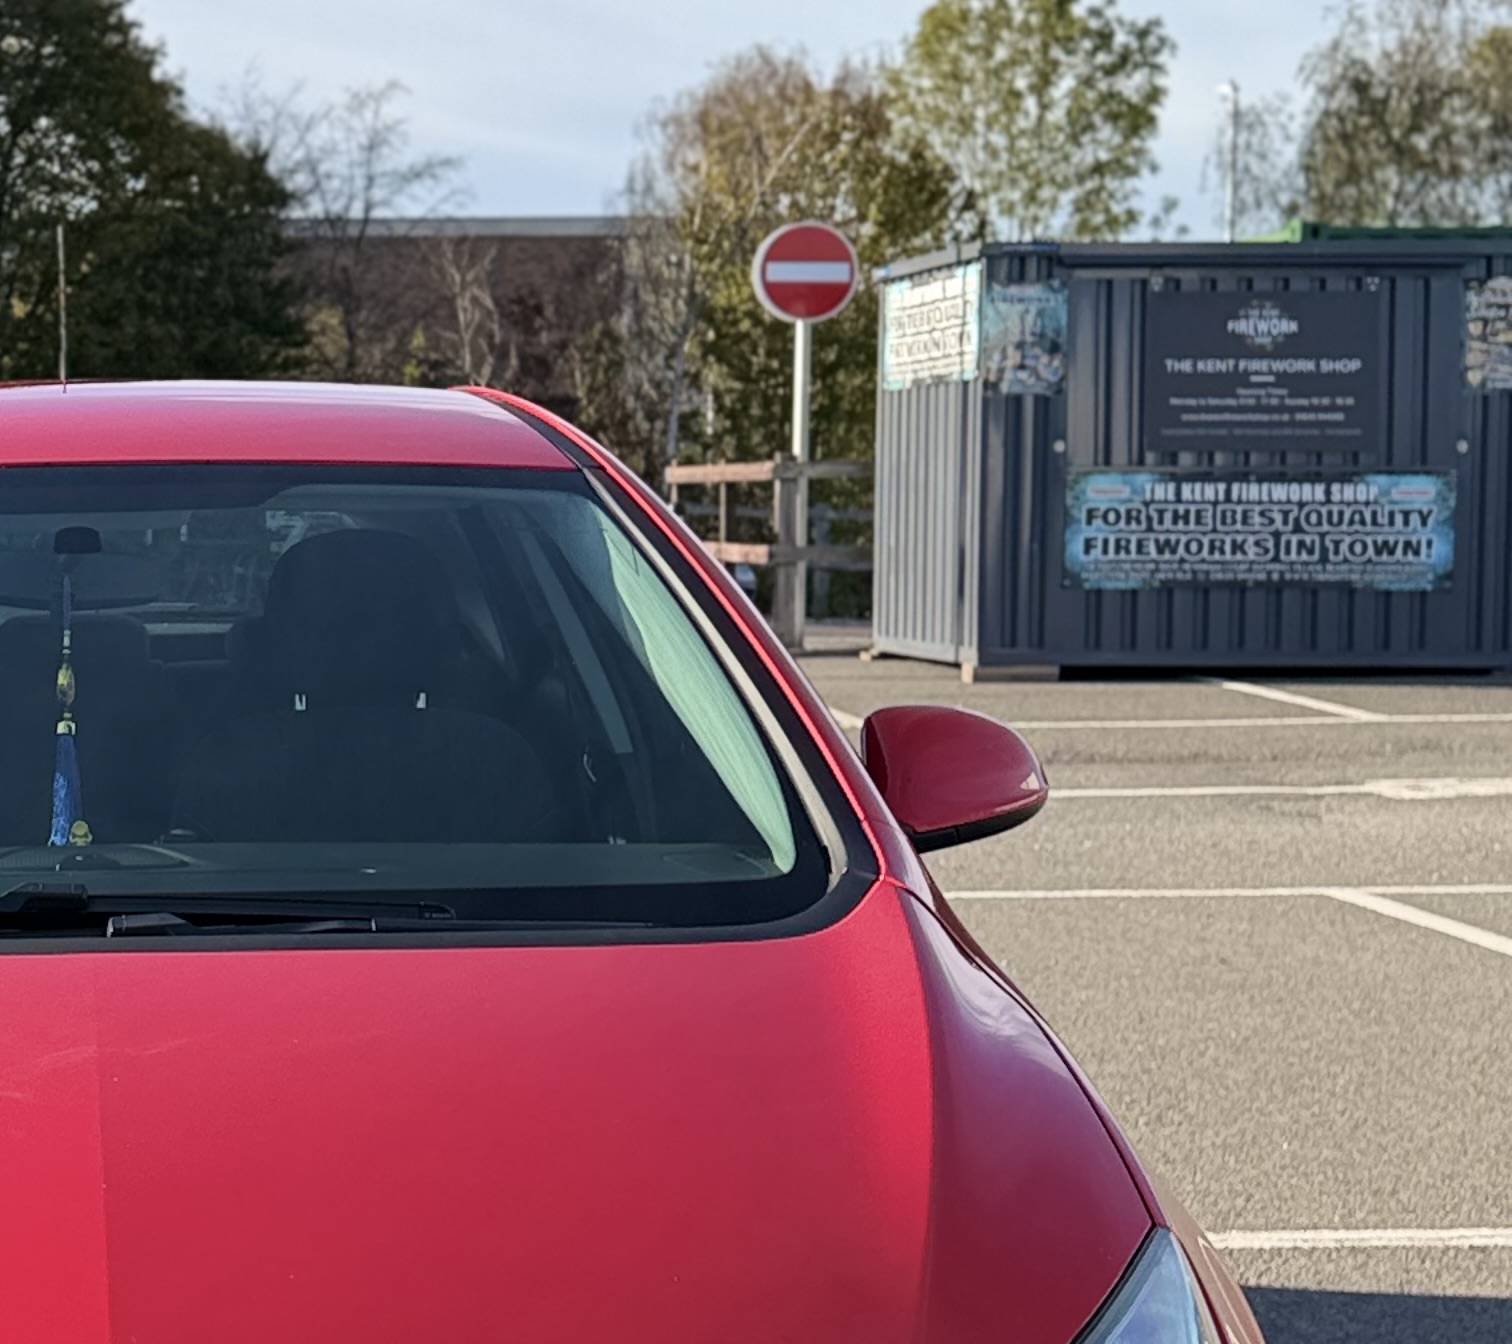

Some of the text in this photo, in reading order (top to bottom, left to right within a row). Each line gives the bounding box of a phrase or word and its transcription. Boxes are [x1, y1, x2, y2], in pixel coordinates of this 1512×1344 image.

[1164, 358, 1362, 374] THE KENT FIREWORK SHOP
[1143, 481, 1177, 503] THE
[1180, 481, 1227, 503] KENT
[1230, 481, 1326, 503] FIREWORK
[1329, 482, 1379, 503] SHOP
[1084, 506, 1435, 529] FOR THE BEST QUALITY
[1082, 535, 1435, 559] FIREWORKS IN TOWN!
